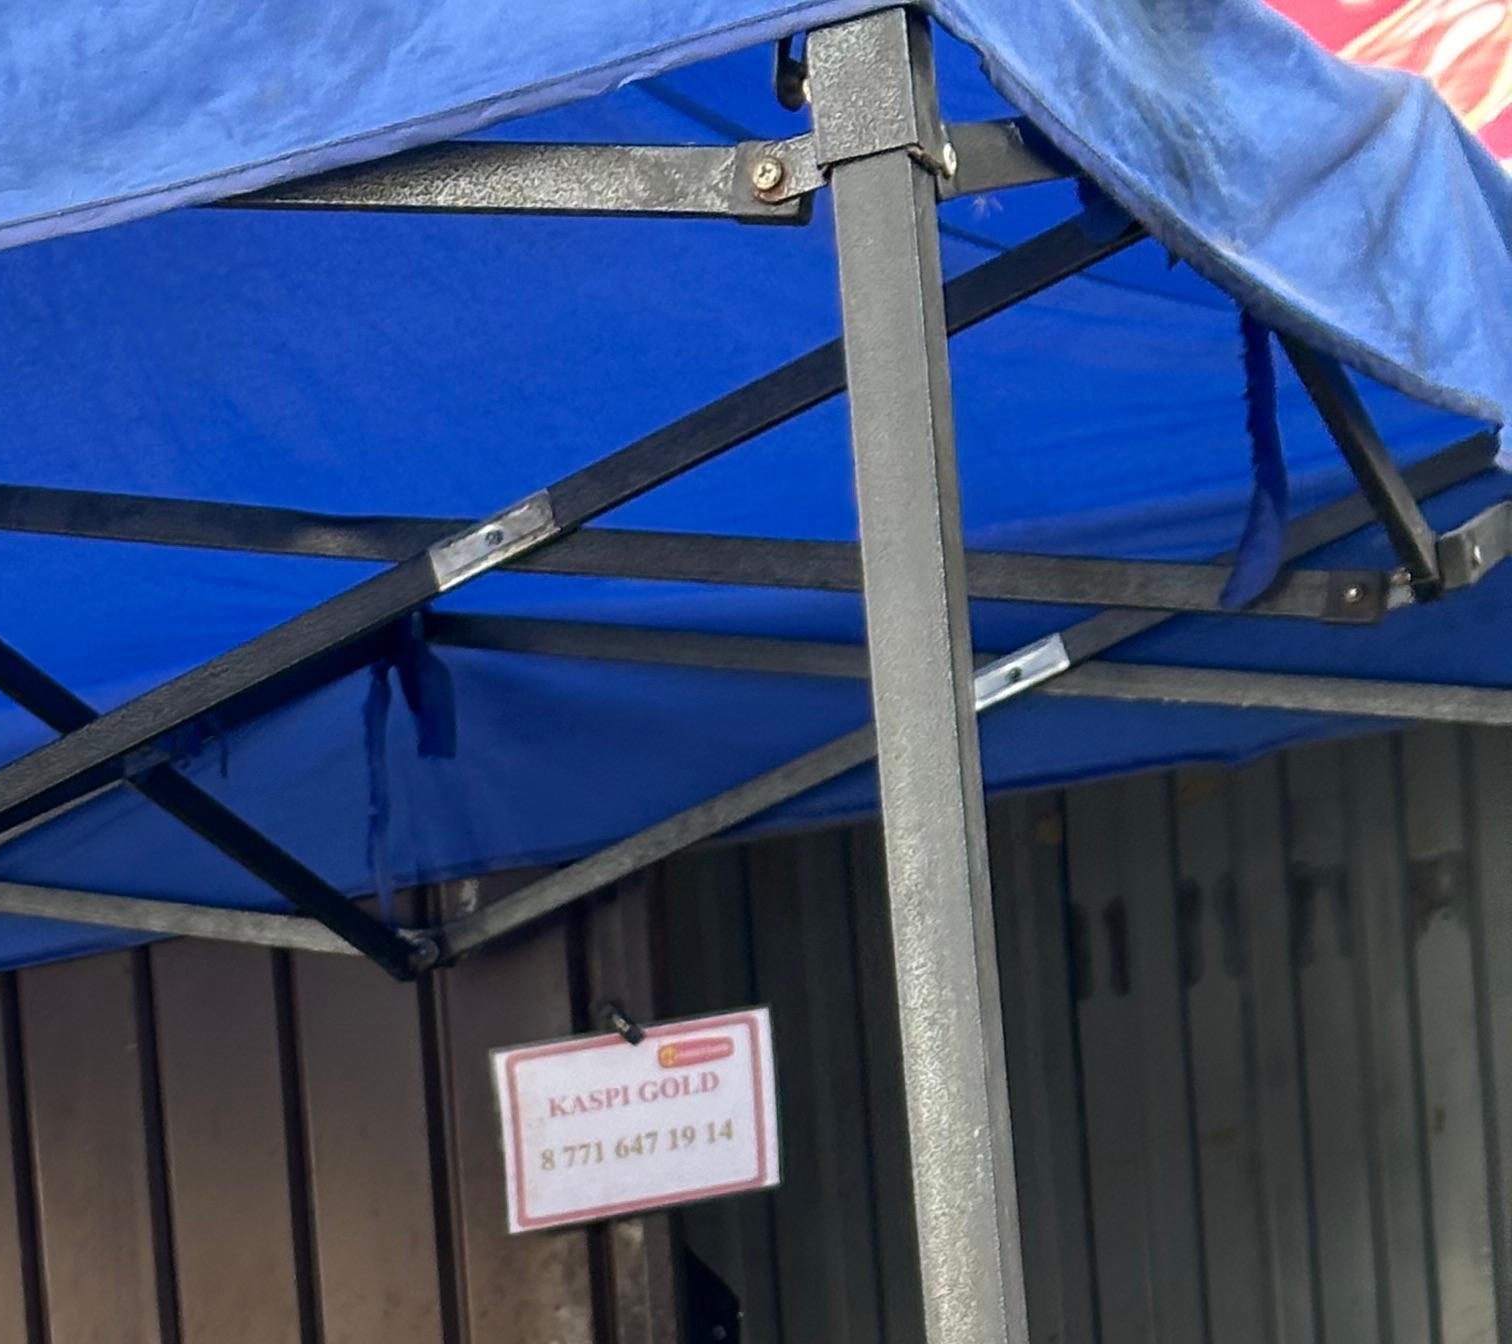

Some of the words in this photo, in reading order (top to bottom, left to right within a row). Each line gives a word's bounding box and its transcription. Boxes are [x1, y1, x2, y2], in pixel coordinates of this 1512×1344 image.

[549, 1083, 630, 1118] KASPI
[639, 1071, 720, 1102] GOLD
[541, 1149, 555, 1171] 8
[563, 1141, 605, 1167] 771
[614, 1132, 659, 1159] 647
[669, 1126, 697, 1151] 19
[707, 1119, 734, 1143] 14
